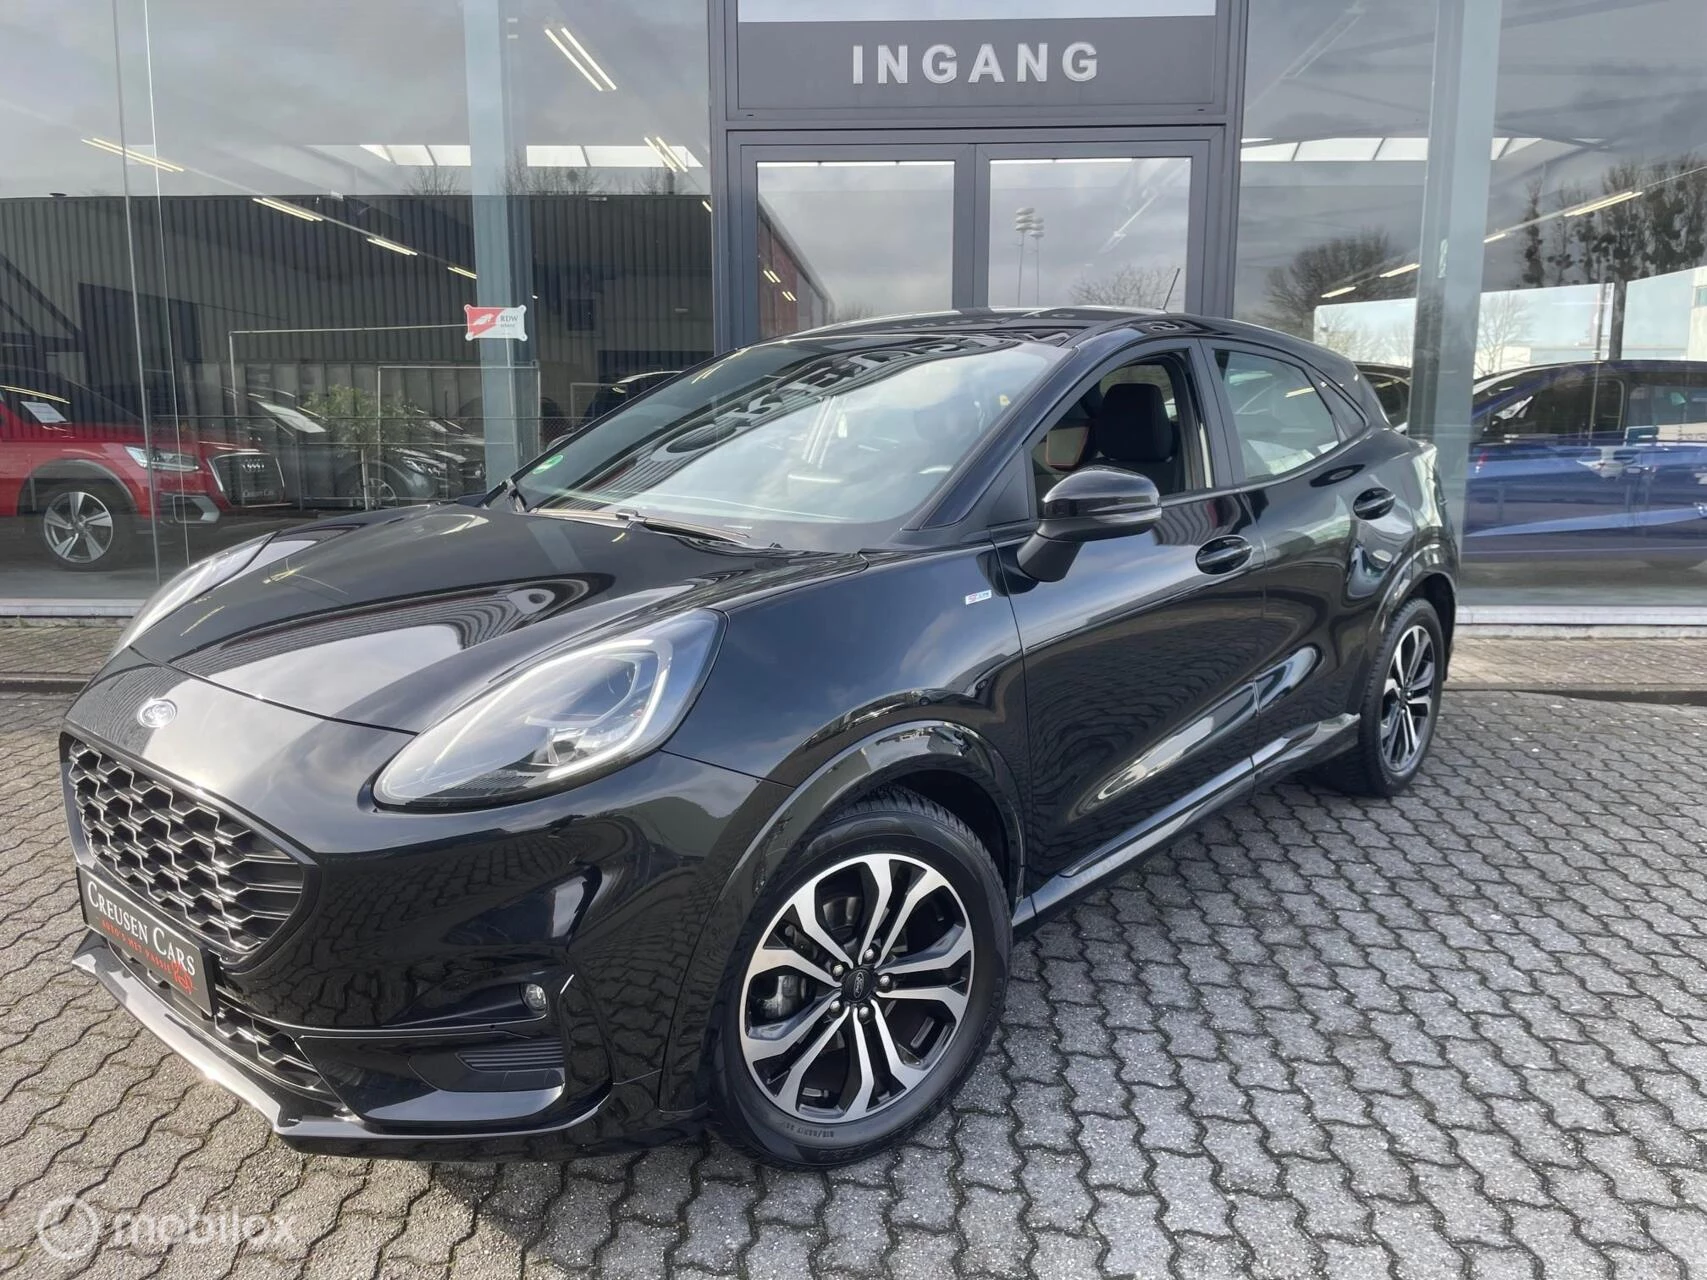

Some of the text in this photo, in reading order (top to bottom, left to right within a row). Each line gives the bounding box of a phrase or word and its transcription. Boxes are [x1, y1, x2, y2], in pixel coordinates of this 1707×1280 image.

[853, 41, 1097, 84] INGANG
[88, 880, 195, 976] CREUSEN CARS
